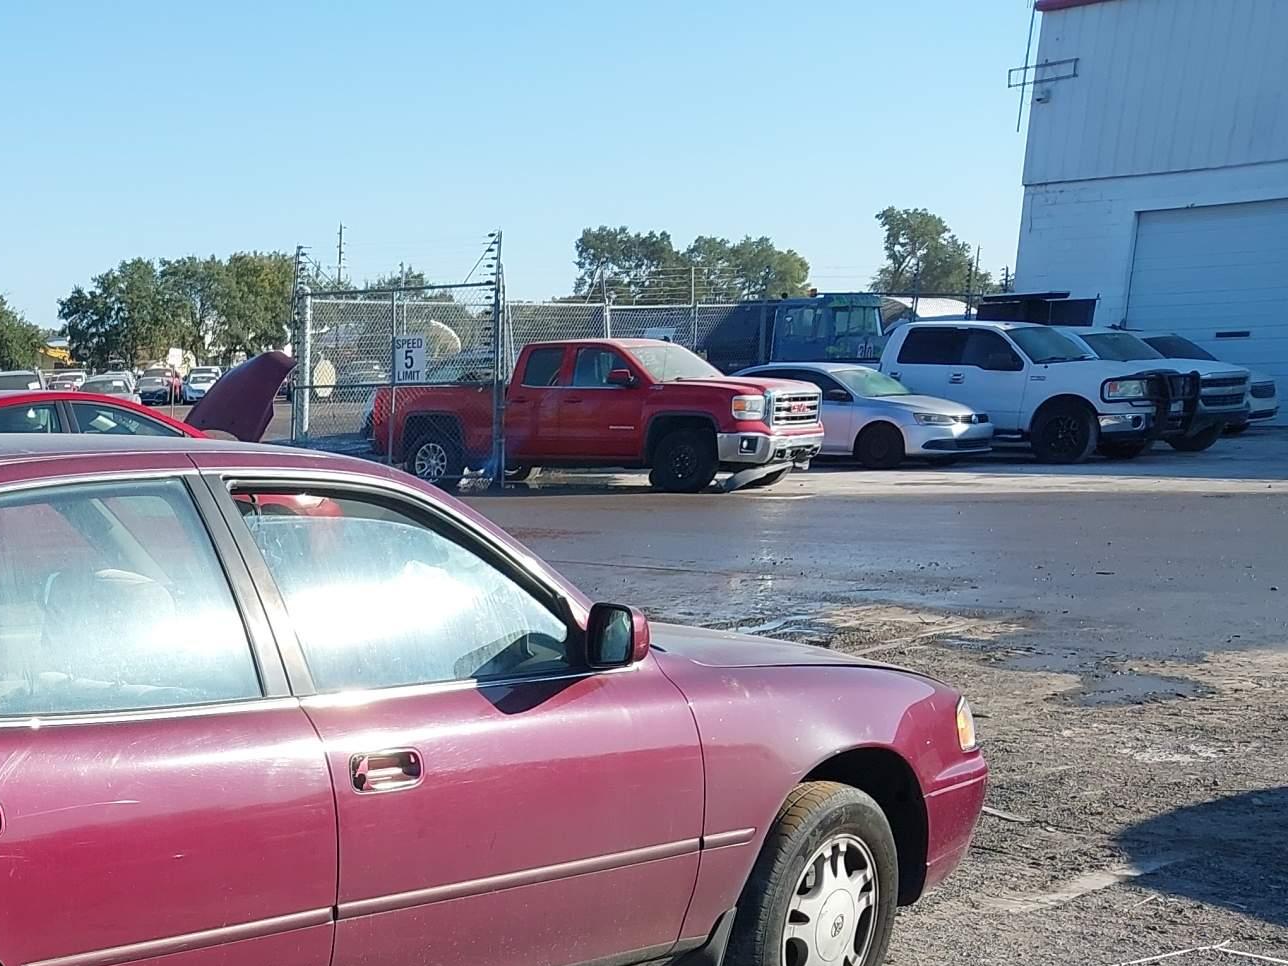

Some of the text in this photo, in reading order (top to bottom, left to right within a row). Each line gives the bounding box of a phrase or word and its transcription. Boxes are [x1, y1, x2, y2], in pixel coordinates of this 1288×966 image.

[396, 338, 423, 349] SPEED
[404, 350, 414, 369] 5
[397, 371, 420, 381] LIMIT
